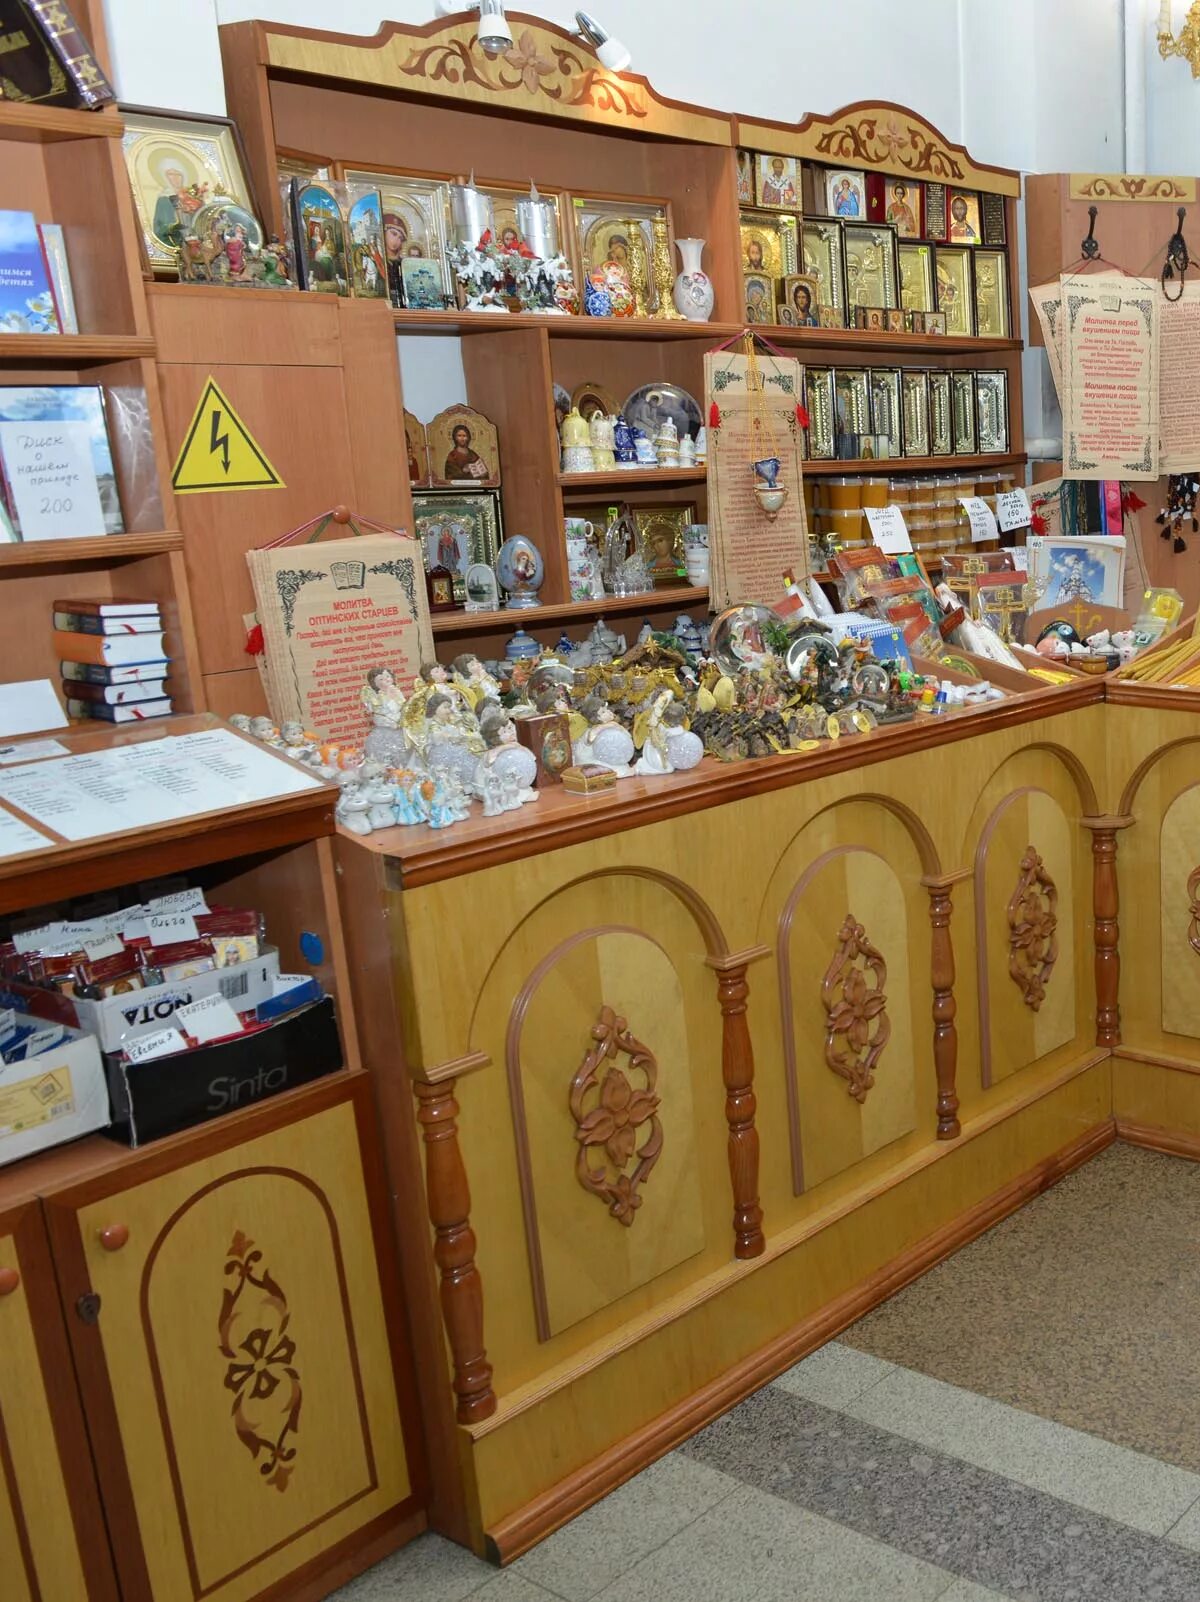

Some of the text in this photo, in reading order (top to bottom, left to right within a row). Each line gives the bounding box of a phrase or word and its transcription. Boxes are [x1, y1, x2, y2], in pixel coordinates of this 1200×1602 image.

[1084, 316, 1138, 328] Молитва перед
[1082, 326, 1120, 334] вкушением
[1084, 382, 1116, 391] Молитва
[16, 434, 64, 449] Диск
[17, 462, 70, 474] нашем
[40, 497, 73, 514] 200
[333, 597, 374, 611] МОЛИТВА
[309, 606, 399, 626] ОПТИНСКИХ СТАРЦЕВ
[151, 918, 186, 928] Ольга
[122, 992, 193, 1026] NOTA
[207, 1065, 288, 1110] Sinta
